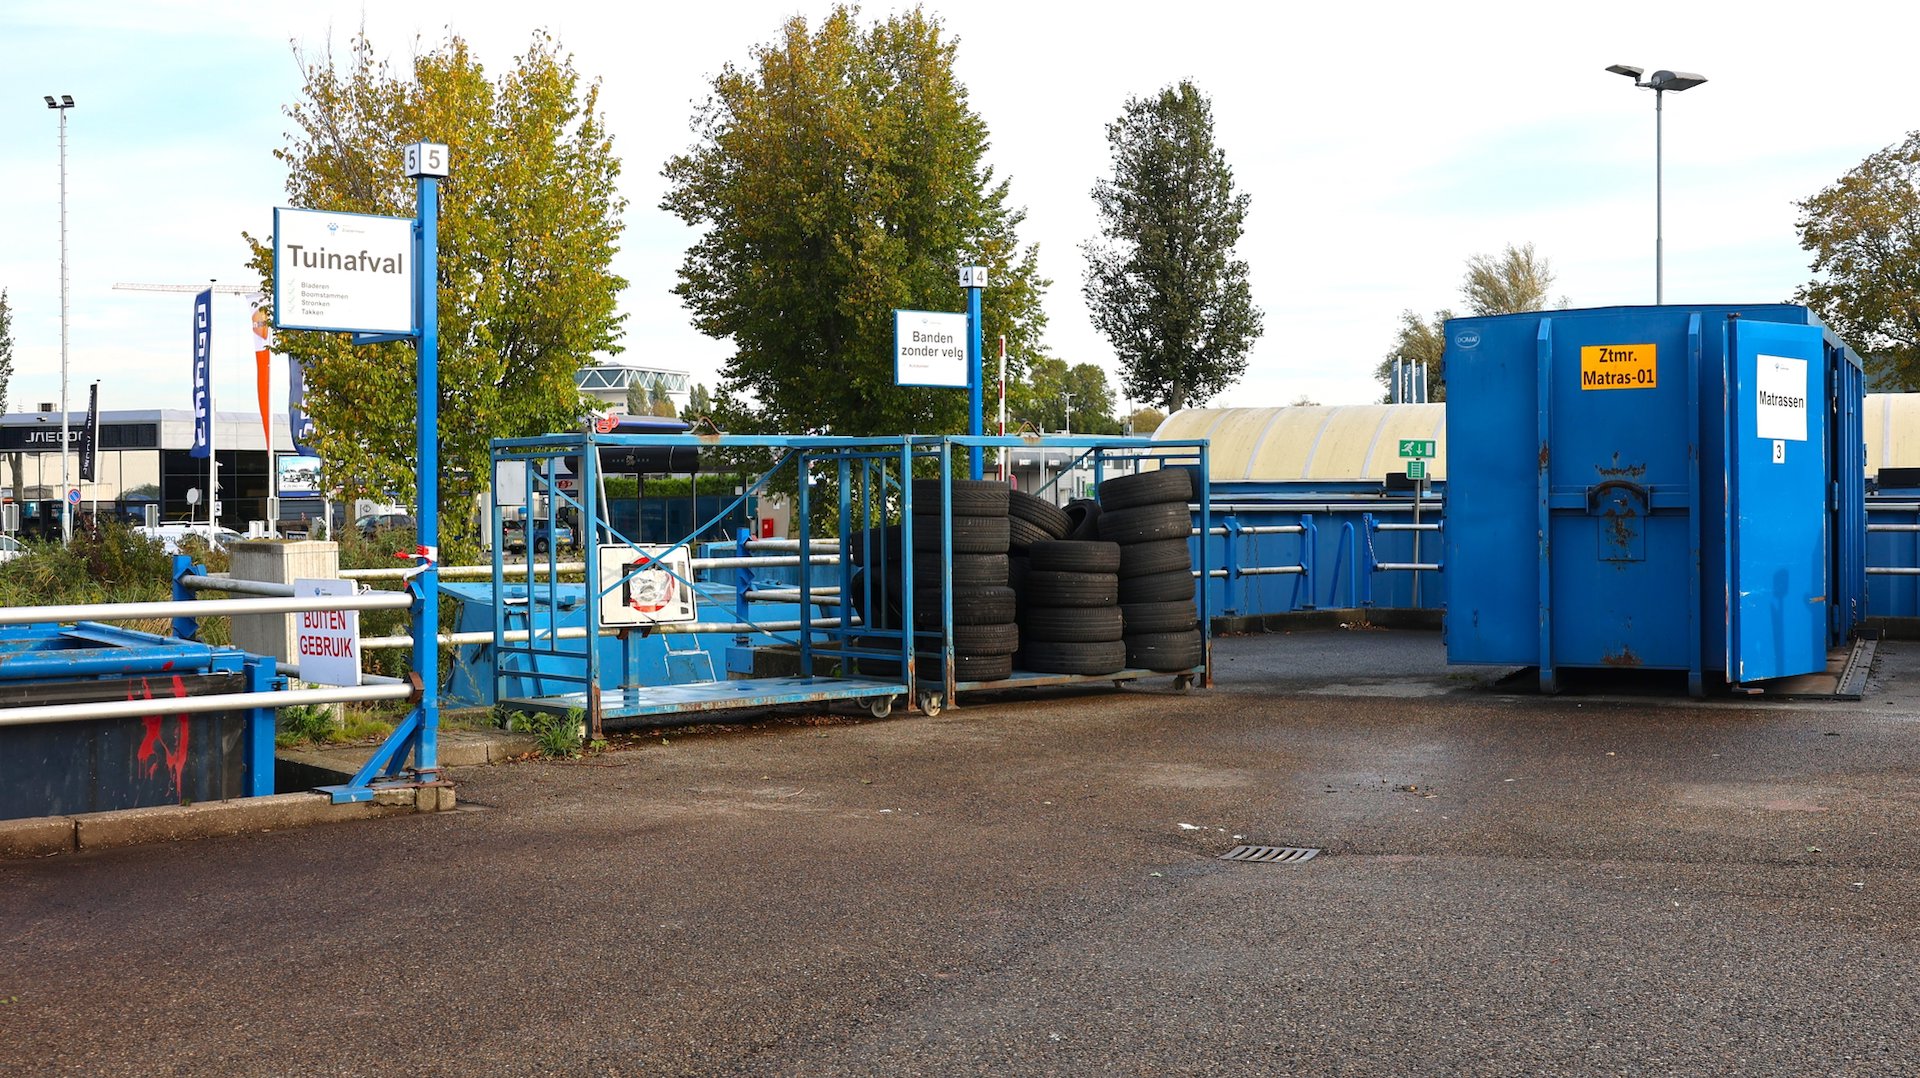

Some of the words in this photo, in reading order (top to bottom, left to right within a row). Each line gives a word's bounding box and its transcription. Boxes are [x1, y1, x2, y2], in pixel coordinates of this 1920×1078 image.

[408, 150, 416, 170] 5
[428, 150, 440, 170] 5
[286, 244, 403, 275] Tuinafval
[962, 270, 969, 283] 4
[976, 271, 984, 282] 4
[300, 281, 330, 290] Bladeren
[300, 290, 349, 300] Boomstammen
[300, 299, 331, 308] Stronken
[300, 308, 324, 316] Takken
[912, 330, 954, 344] Banden
[901, 345, 939, 358] zonder
[941, 347, 964, 361] velg
[1599, 348, 1638, 363] Ztmr.
[1583, 368, 1655, 386] Matras-01
[1759, 390, 1805, 409] Matrassen
[1776, 444, 1782, 459] 3
[304, 610, 346, 630] BUITEN
[300, 635, 353, 658] GEBRUIK
